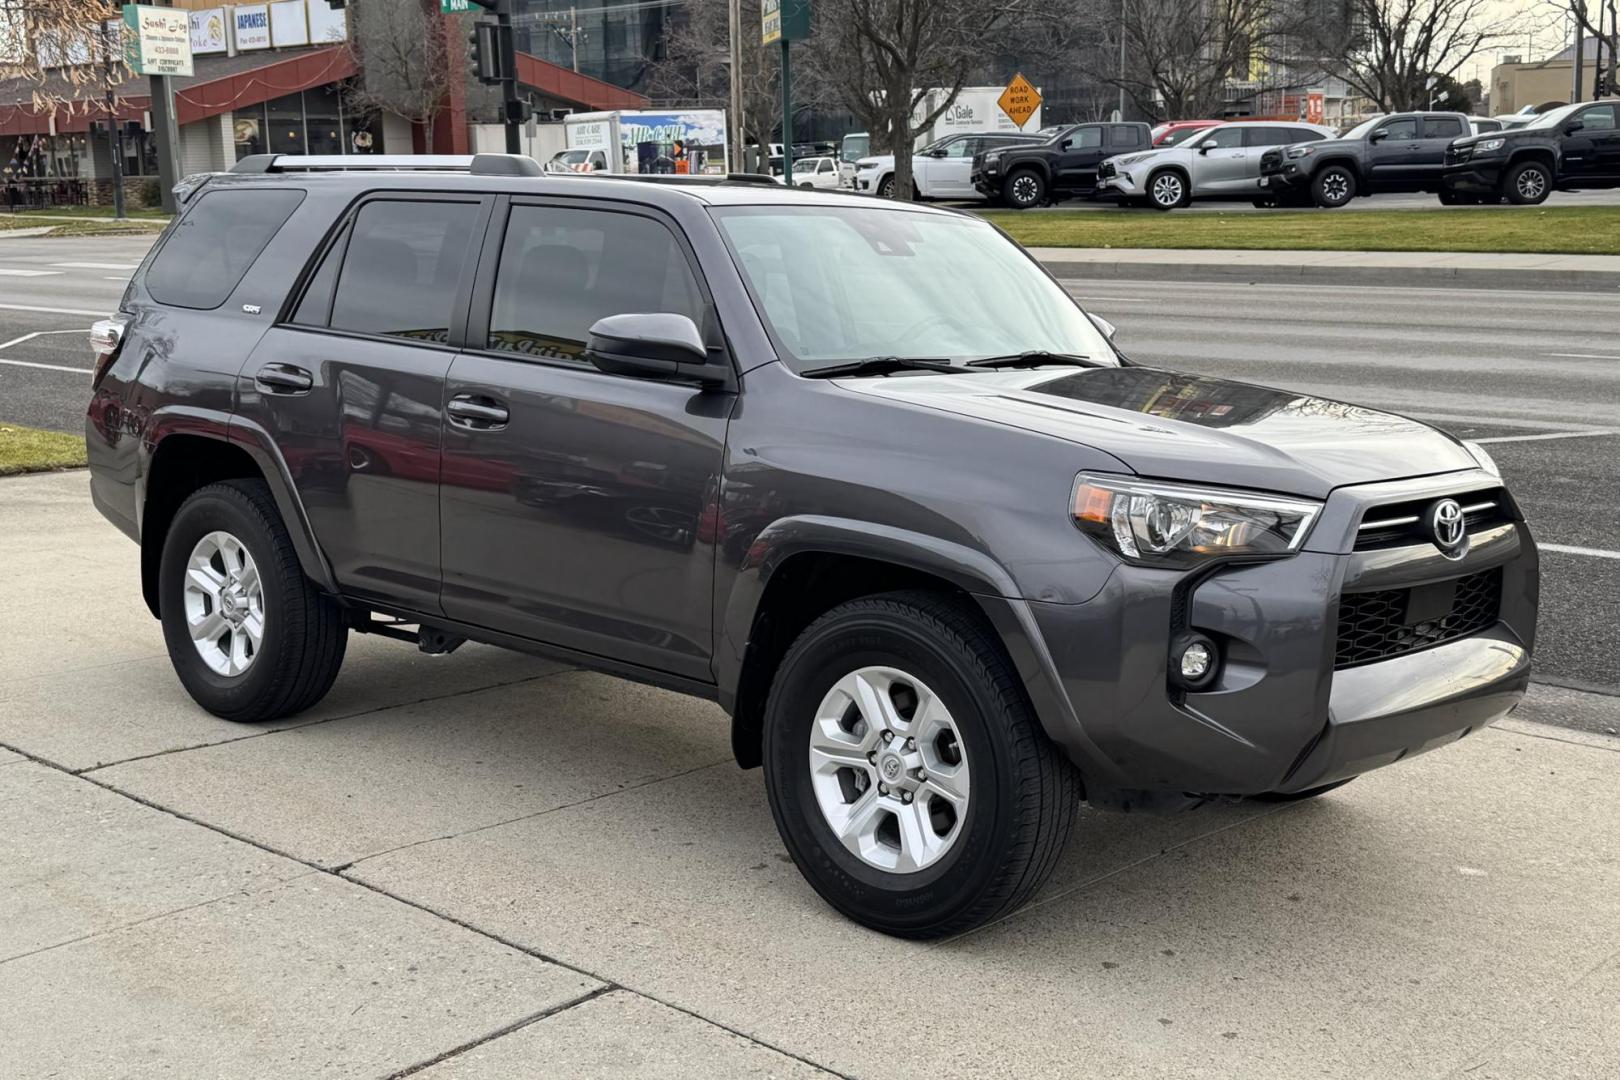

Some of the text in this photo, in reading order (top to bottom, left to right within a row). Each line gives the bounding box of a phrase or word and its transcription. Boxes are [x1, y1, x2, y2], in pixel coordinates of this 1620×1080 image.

[142, 17, 187, 33] Sushi Joy
[237, 13, 267, 29] JAPANESE
[1010, 85, 1028, 94] ROAD
[1010, 96, 1029, 104] WORK
[955, 105, 973, 119] Gale
[1009, 106, 1031, 115] AHEAD
